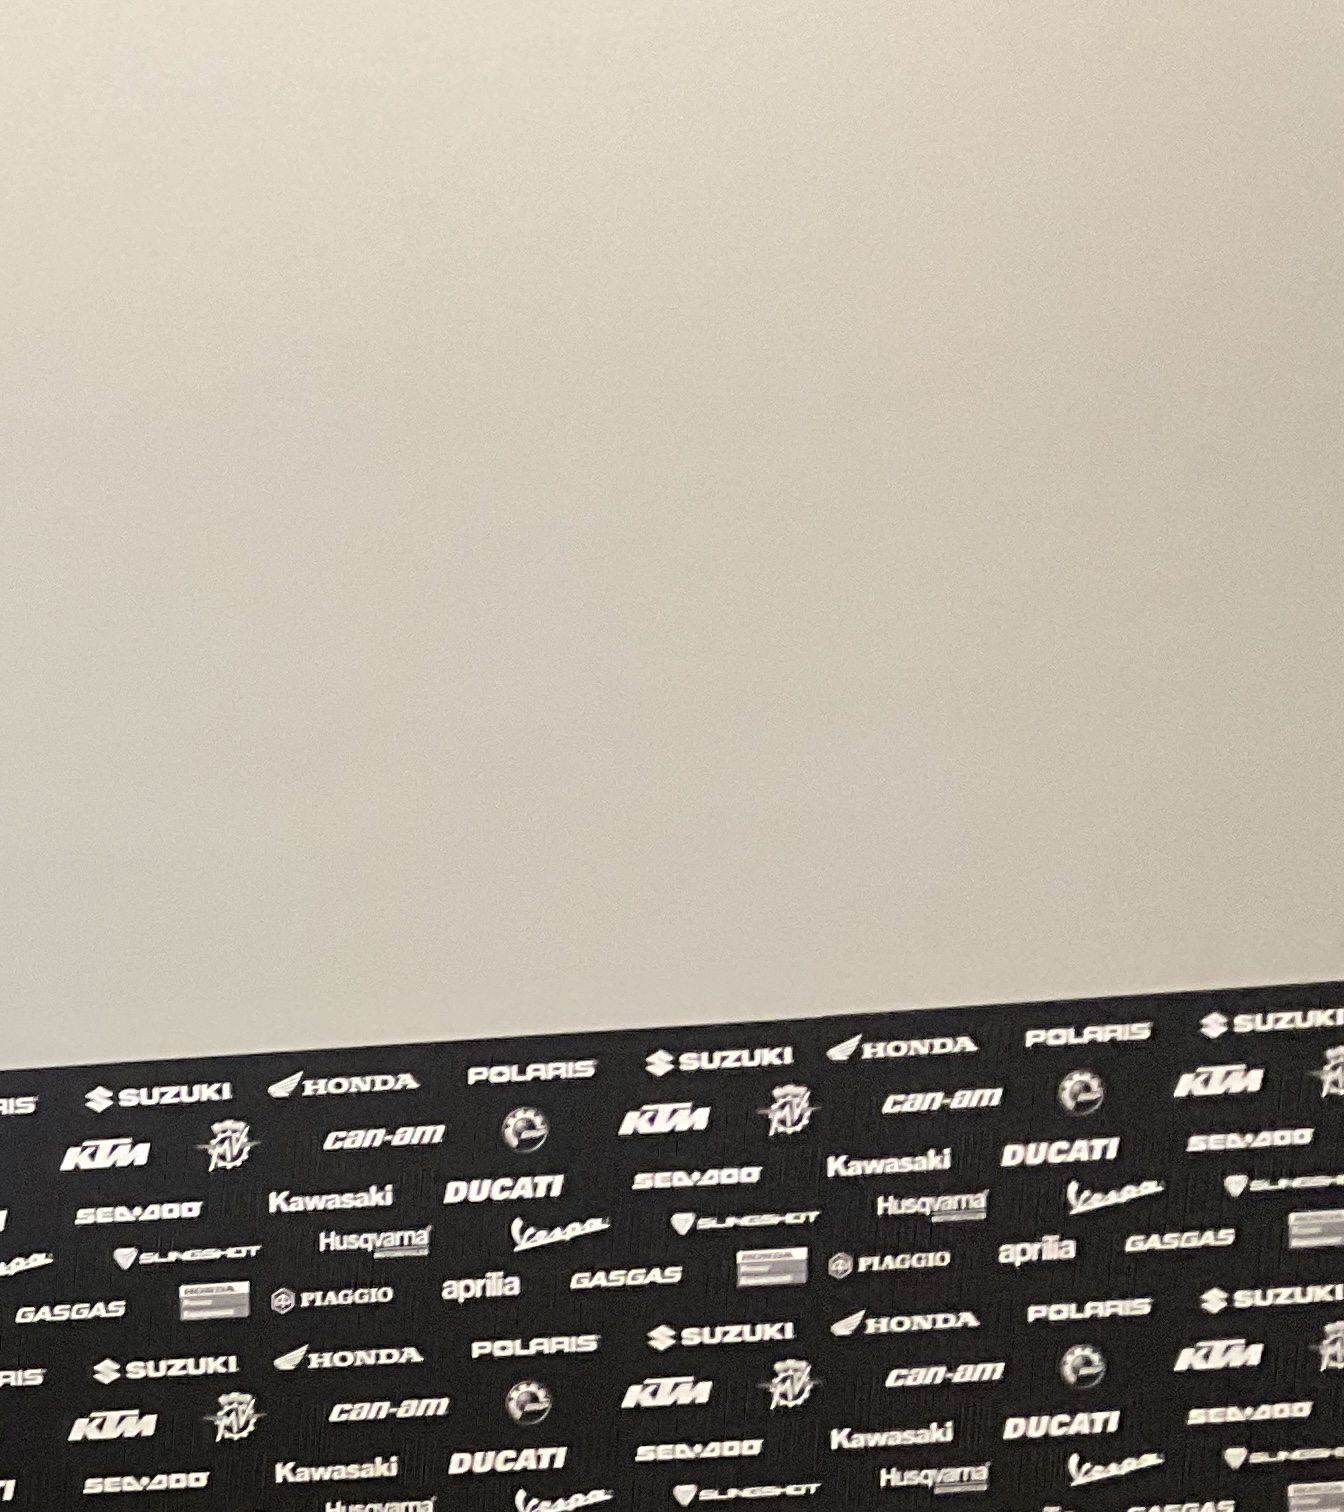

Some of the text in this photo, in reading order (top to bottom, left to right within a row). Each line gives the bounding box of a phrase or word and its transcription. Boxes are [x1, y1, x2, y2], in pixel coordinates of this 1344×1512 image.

[1233, 1008, 1344, 1032] SUZUKI
[1025, 1022, 1152, 1047] POLARIS
[679, 1046, 794, 1071] SUZUKI
[861, 1036, 978, 1059] HONDA
[303, 1073, 420, 1096] HONDA
[468, 1060, 597, 1085] POLARIS
[1173, 1064, 1264, 1097] KTM
[119, 1082, 232, 1107] SUZUKI
[618, 1102, 711, 1135] KTM
[60, 1138, 150, 1171] KTM
[827, 1148, 951, 1177] Kawasaki
[1001, 1137, 1120, 1167] DUCATI
[269, 1184, 393, 1213] Kawasaki
[443, 1174, 564, 1204] DUCATI
[877, 1189, 989, 1215] Husqvarna
[319, 1225, 432, 1252] Husqvarna
[998, 1235, 1076, 1267] aprilia
[1125, 1229, 1235, 1252] GASGAS
[858, 1251, 950, 1272] PIAGGIO
[442, 1271, 520, 1303] aprilia
[570, 1266, 683, 1289] GASGAS
[301, 1287, 393, 1307] PIAGGIO
[1233, 1284, 1344, 1308] SUZUKI
[15, 1300, 126, 1323] GASGAS
[1027, 1298, 1153, 1322] POLARIS
[681, 1322, 794, 1345] SUZUKI
[865, 1312, 980, 1334] HONDA
[308, 1347, 424, 1368] HONDA
[472, 1335, 600, 1358] POLARIS
[1174, 1339, 1264, 1371] KTM
[126, 1356, 239, 1379] SUZUKI
[621, 1376, 712, 1408] KTM
[68, 1409, 157, 1441] KTM
[831, 1421, 953, 1450] Kawasaki
[1003, 1411, 1120, 1440] DUCATI
[275, 1456, 398, 1483] Kawasaki
[448, 1447, 567, 1474] DUCATI
[880, 1462, 990, 1488] Husqvarna
